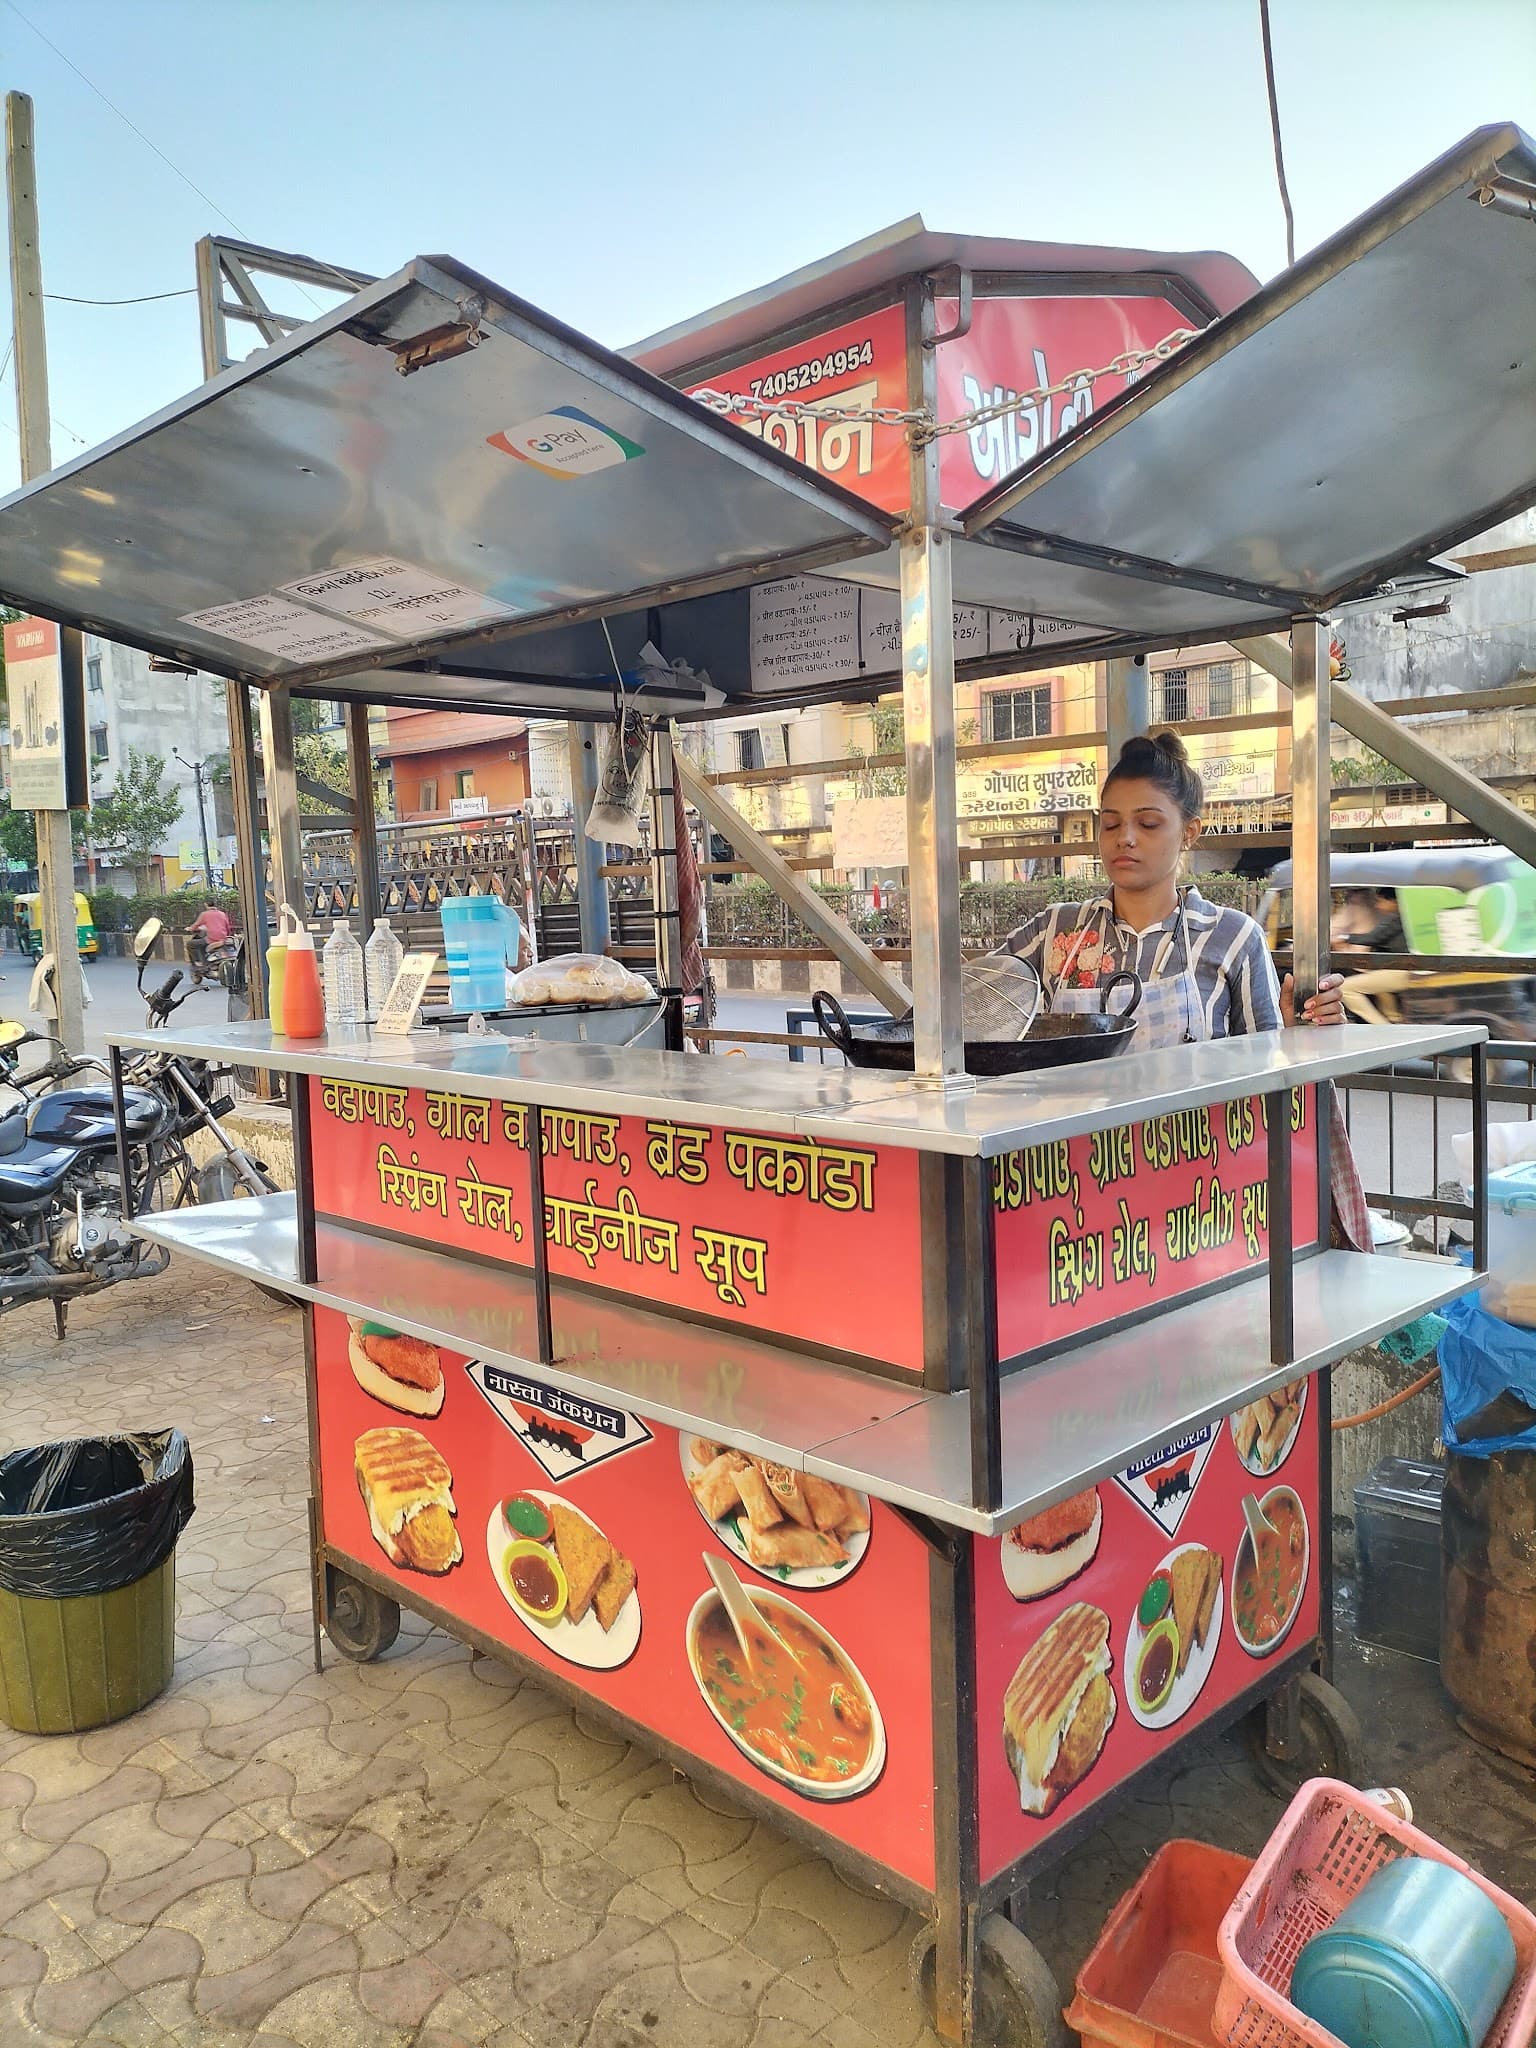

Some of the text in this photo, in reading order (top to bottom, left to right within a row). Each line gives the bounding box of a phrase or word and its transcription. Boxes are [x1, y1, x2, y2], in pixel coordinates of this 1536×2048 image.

[749, 340, 874, 402] 7405294954
[960, 628, 981, 640] 25/-
[455, 1161, 523, 1242] रोल,
[693, 1227, 768, 1306] सूप
[1112, 1198, 1157, 1286] રોલ,
[487, 1372, 619, 1434] नास्ता जंकशन
